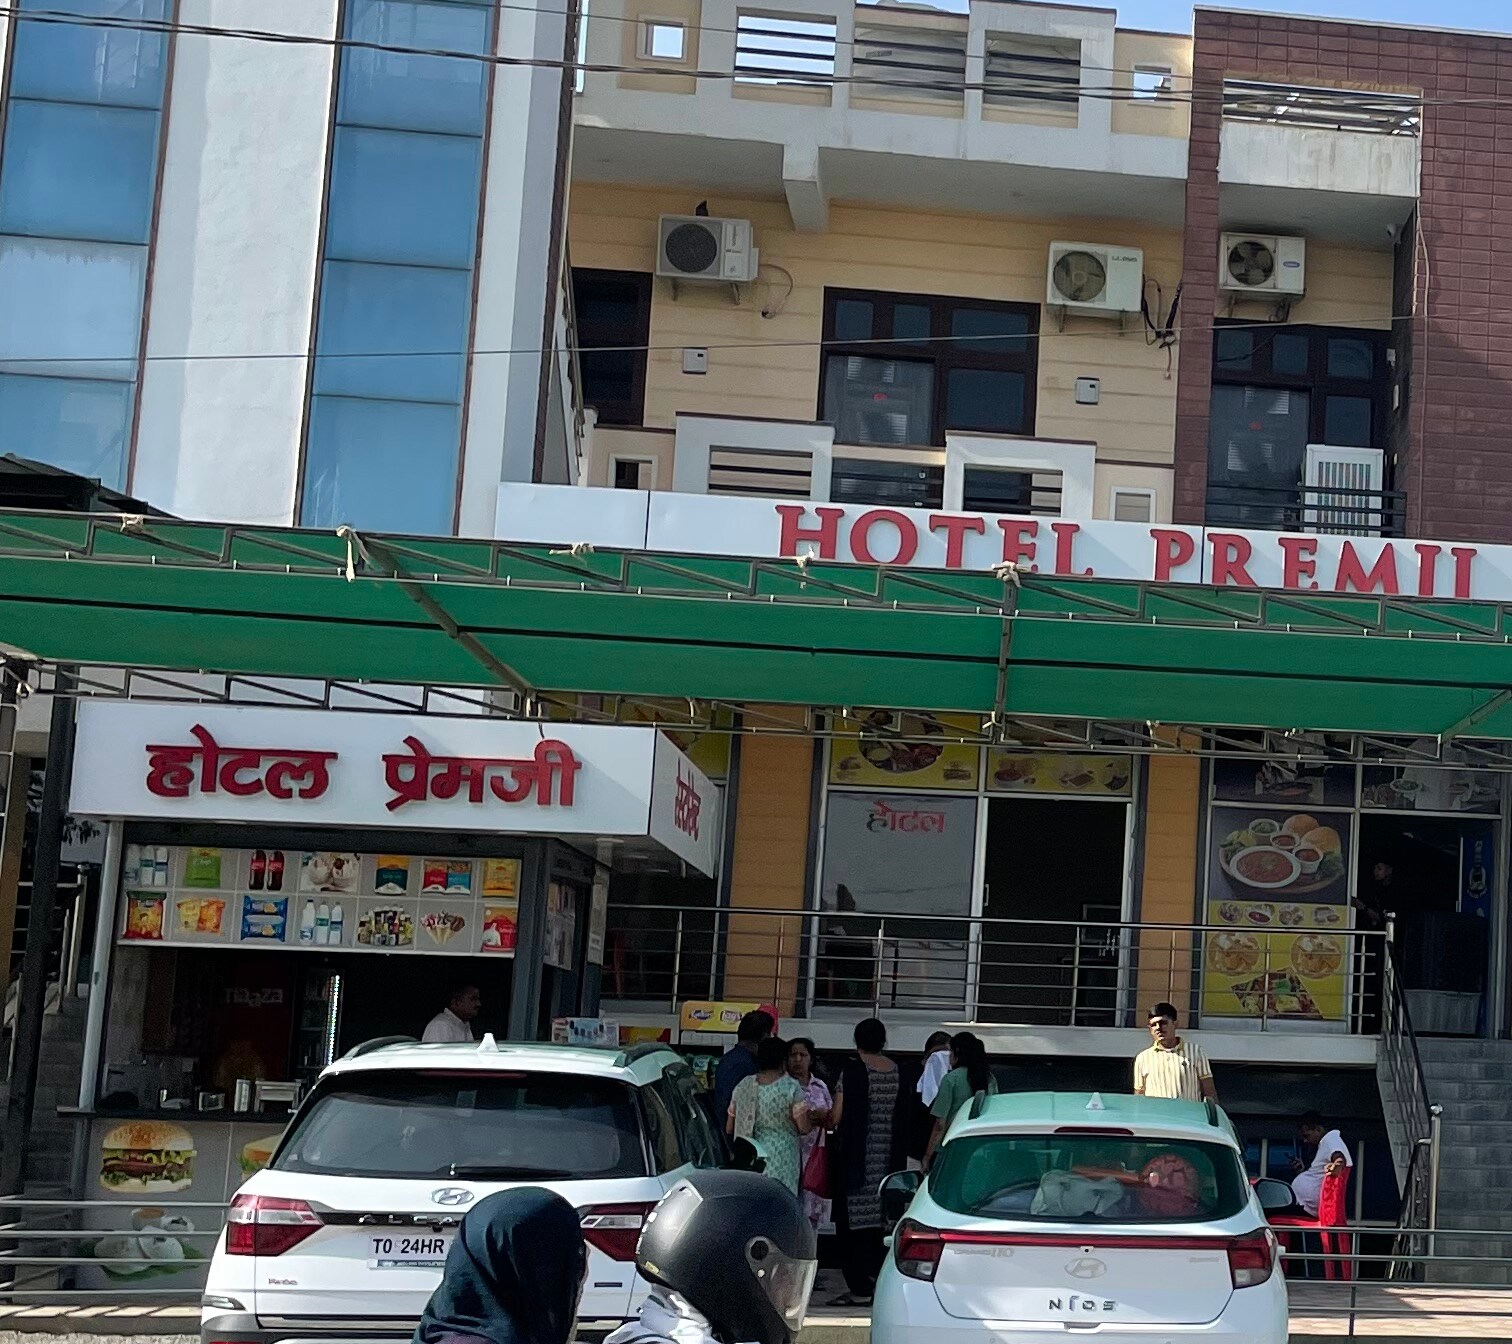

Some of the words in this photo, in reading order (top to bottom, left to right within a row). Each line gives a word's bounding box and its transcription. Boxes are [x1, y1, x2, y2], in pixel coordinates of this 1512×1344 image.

[774, 504, 1094, 577] HOTEL
[145, 722, 339, 800] होटल
[381, 734, 582, 812] प्रेमजी
